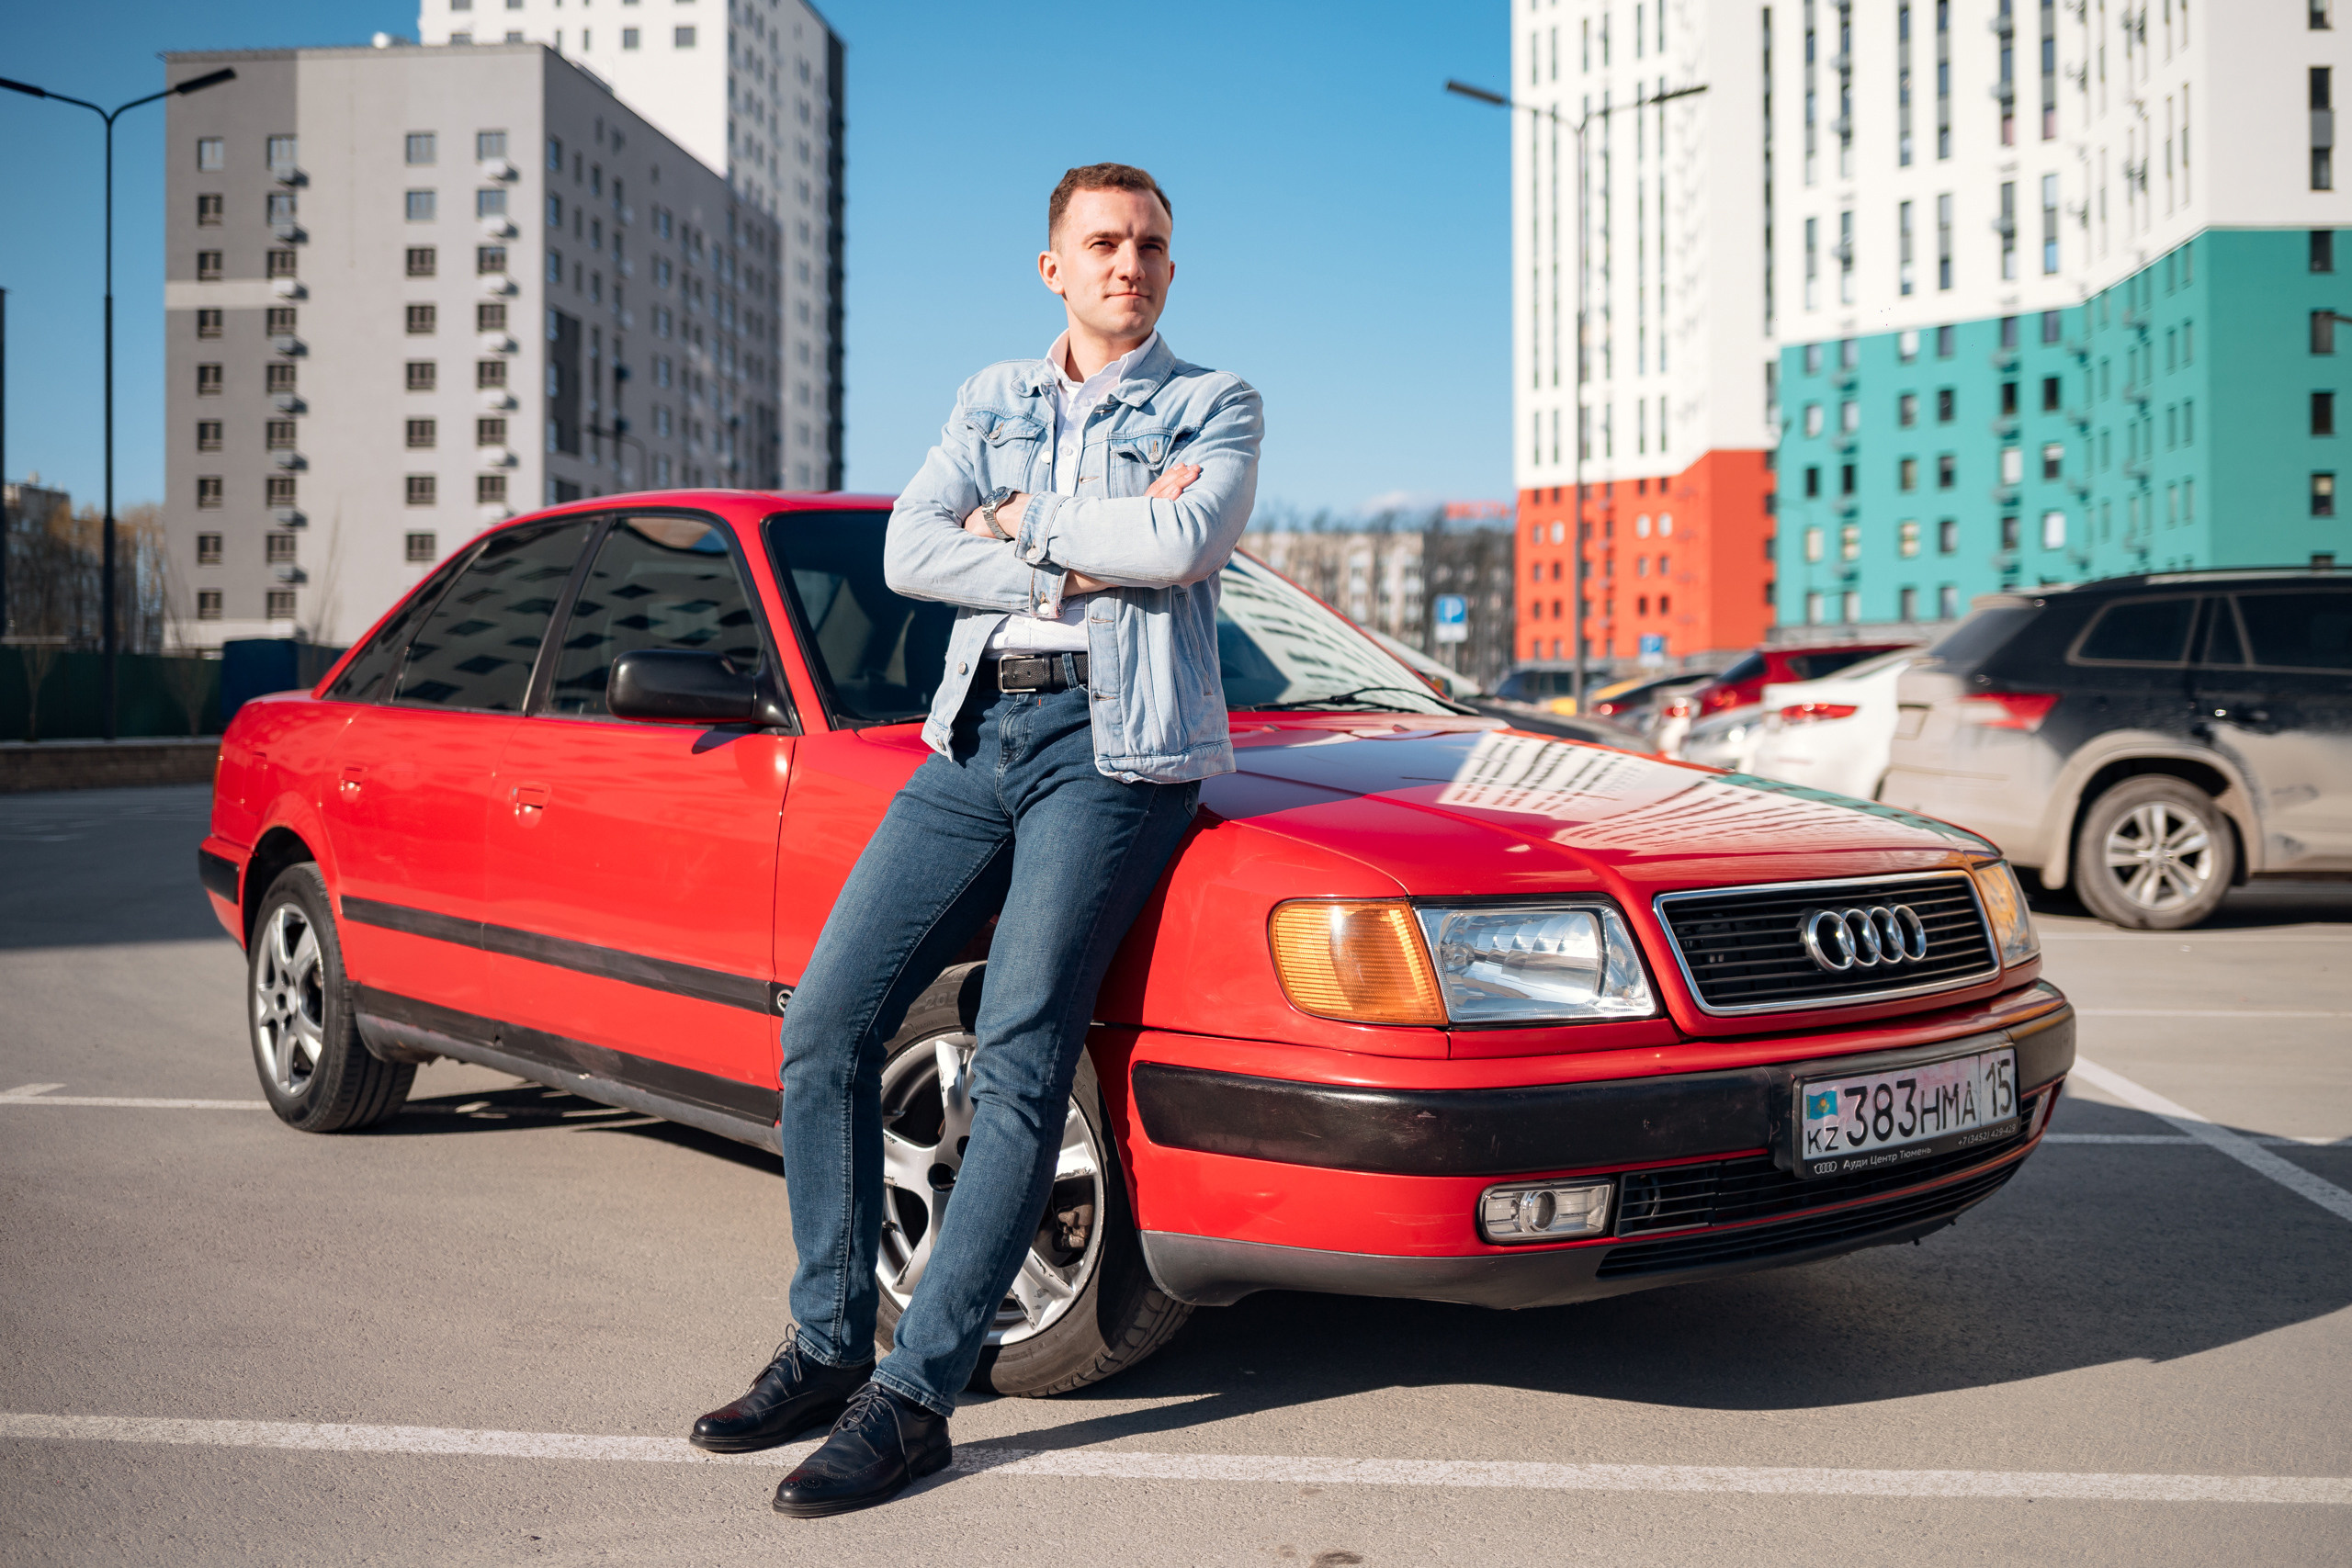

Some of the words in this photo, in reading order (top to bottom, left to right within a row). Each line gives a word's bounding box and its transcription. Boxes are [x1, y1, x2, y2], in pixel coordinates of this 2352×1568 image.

[1986, 1058, 2012, 1117] 15
[1807, 1126, 1838, 1154] KZ
[1843, 1159, 1868, 1170] Ауди
[1870, 1153, 1897, 1164] Центр
[1899, 1146, 1932, 1159] Тюмень
